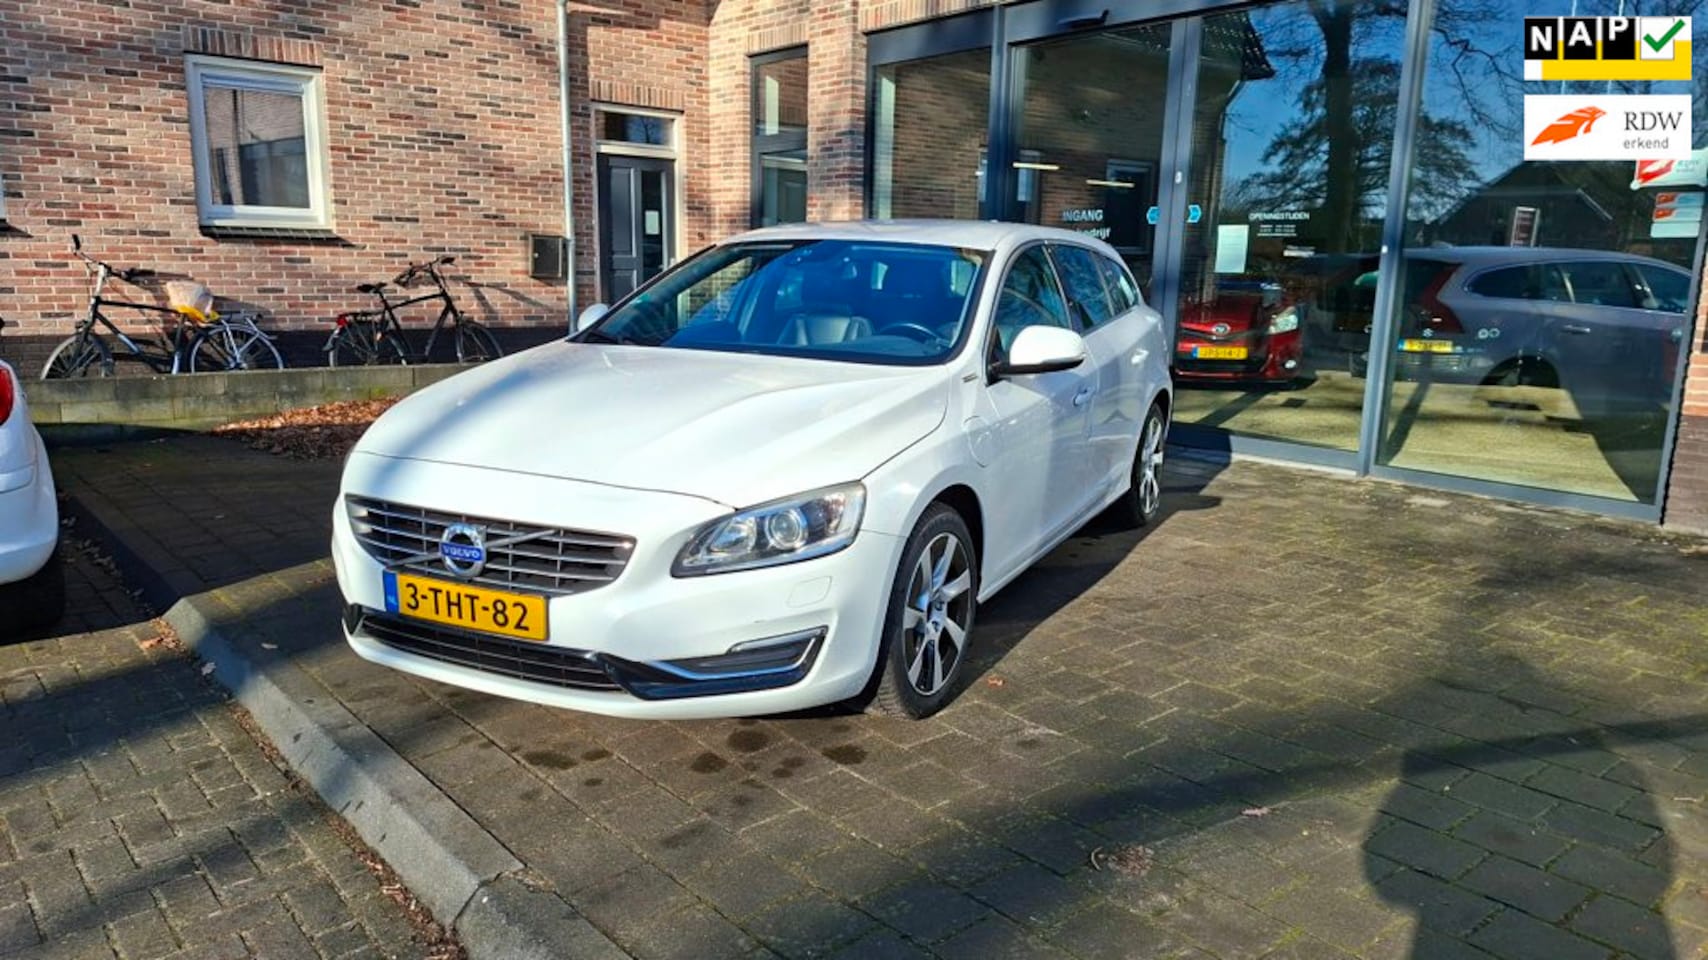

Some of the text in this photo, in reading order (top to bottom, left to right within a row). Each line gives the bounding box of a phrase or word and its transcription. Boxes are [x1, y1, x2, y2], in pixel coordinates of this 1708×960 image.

[1062, 209, 1104, 221] INGANG
[442, 544, 481, 559] VOLVO
[405, 583, 530, 631] 3-THT-82
